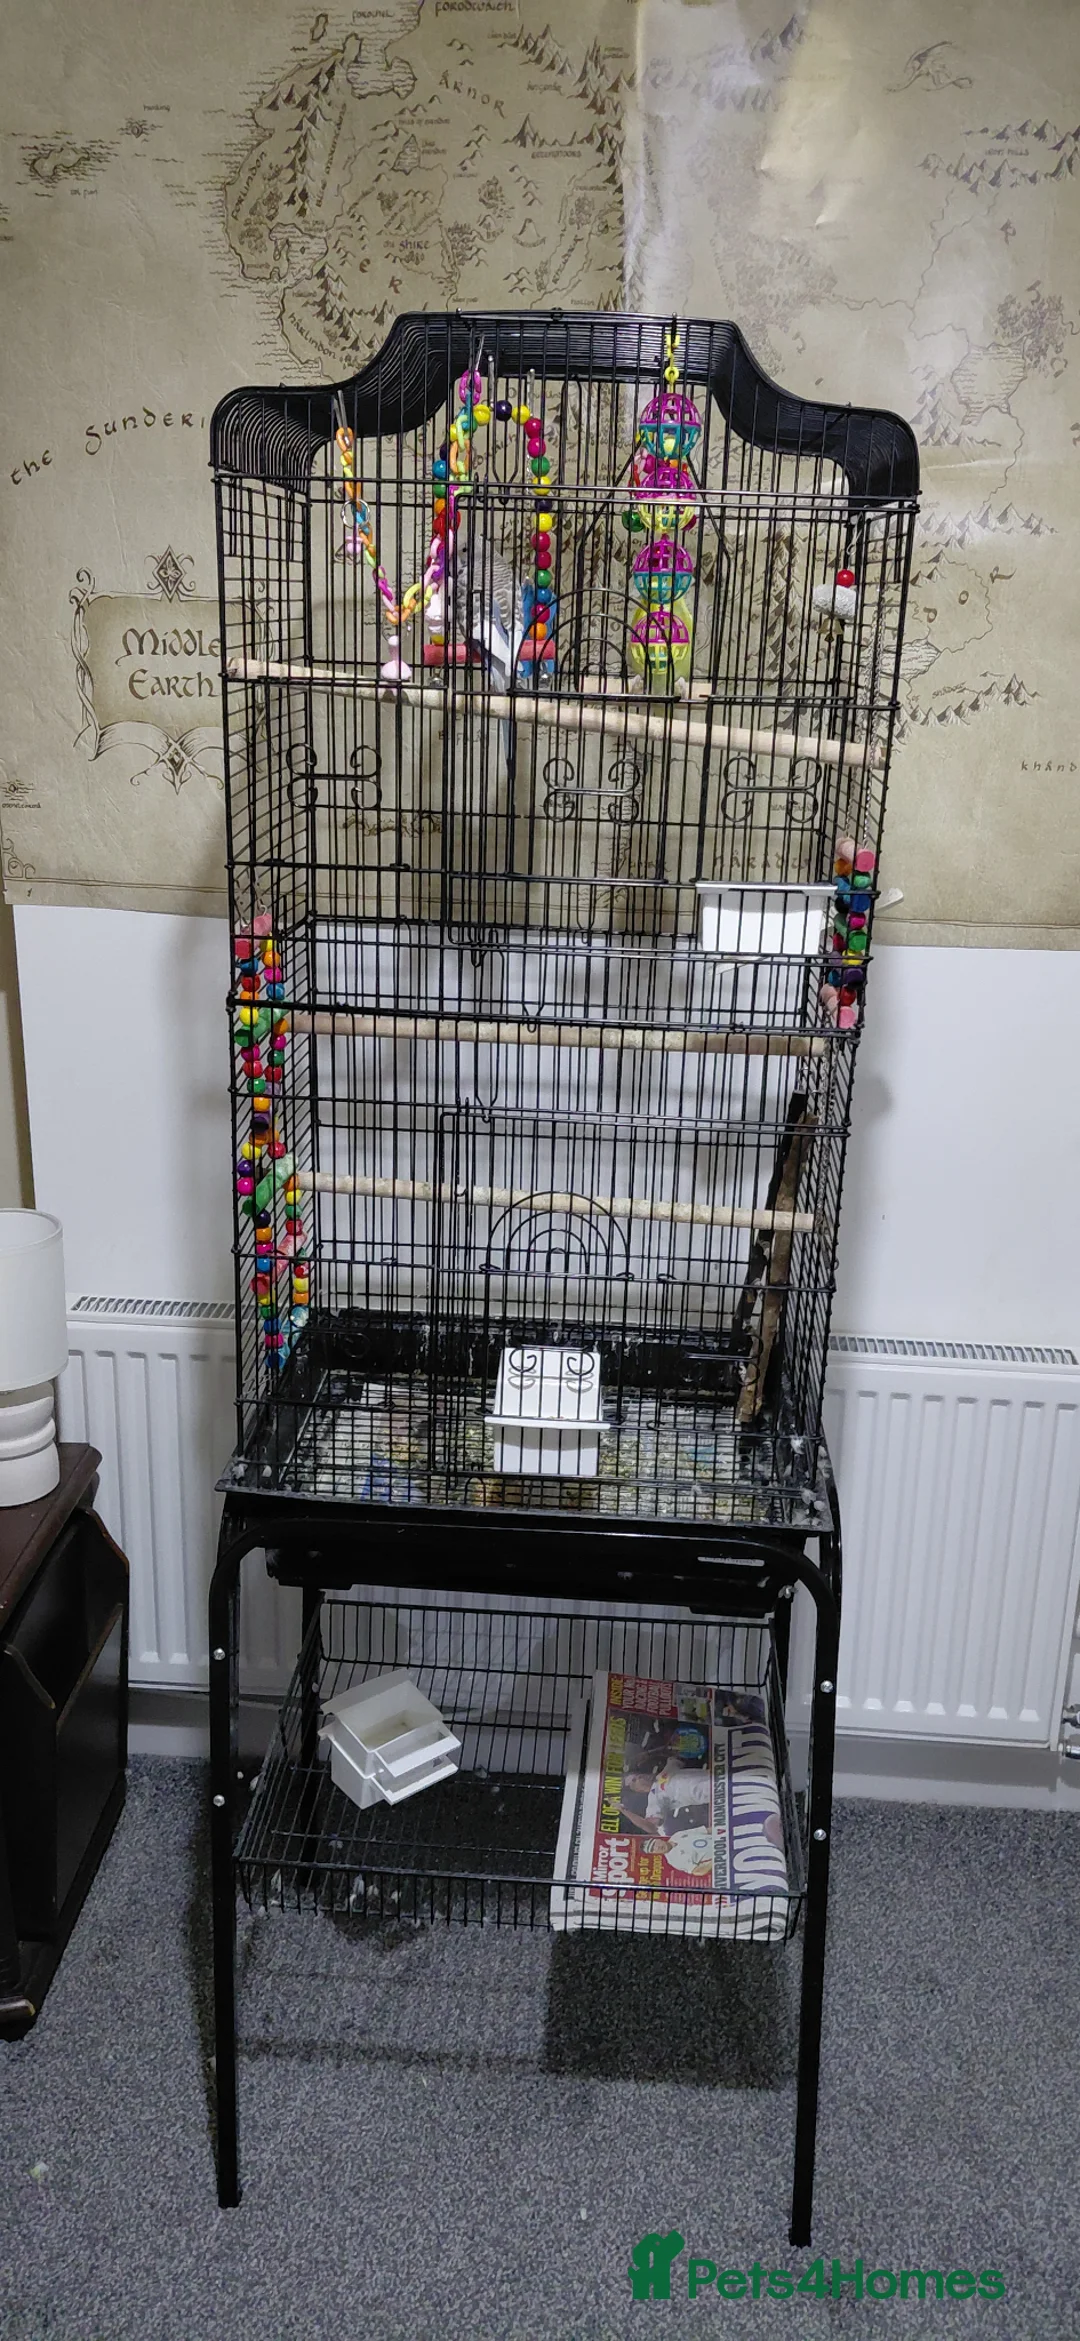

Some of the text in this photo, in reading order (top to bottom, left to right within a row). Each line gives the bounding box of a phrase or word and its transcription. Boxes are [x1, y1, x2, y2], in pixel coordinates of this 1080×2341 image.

[114, 628, 221, 668] Middle
[128, 668, 220, 701] Earth
[605, 1752, 624, 1774] FOR
[713, 1743, 727, 1763] CITY
[604, 1776, 622, 1795] WIN
[713, 1764, 727, 1827] MANCHESTER
[731, 1729, 790, 1894] YOU WANT
[592, 1845, 610, 1882] Mirror
[602, 1837, 635, 1897] Sport
